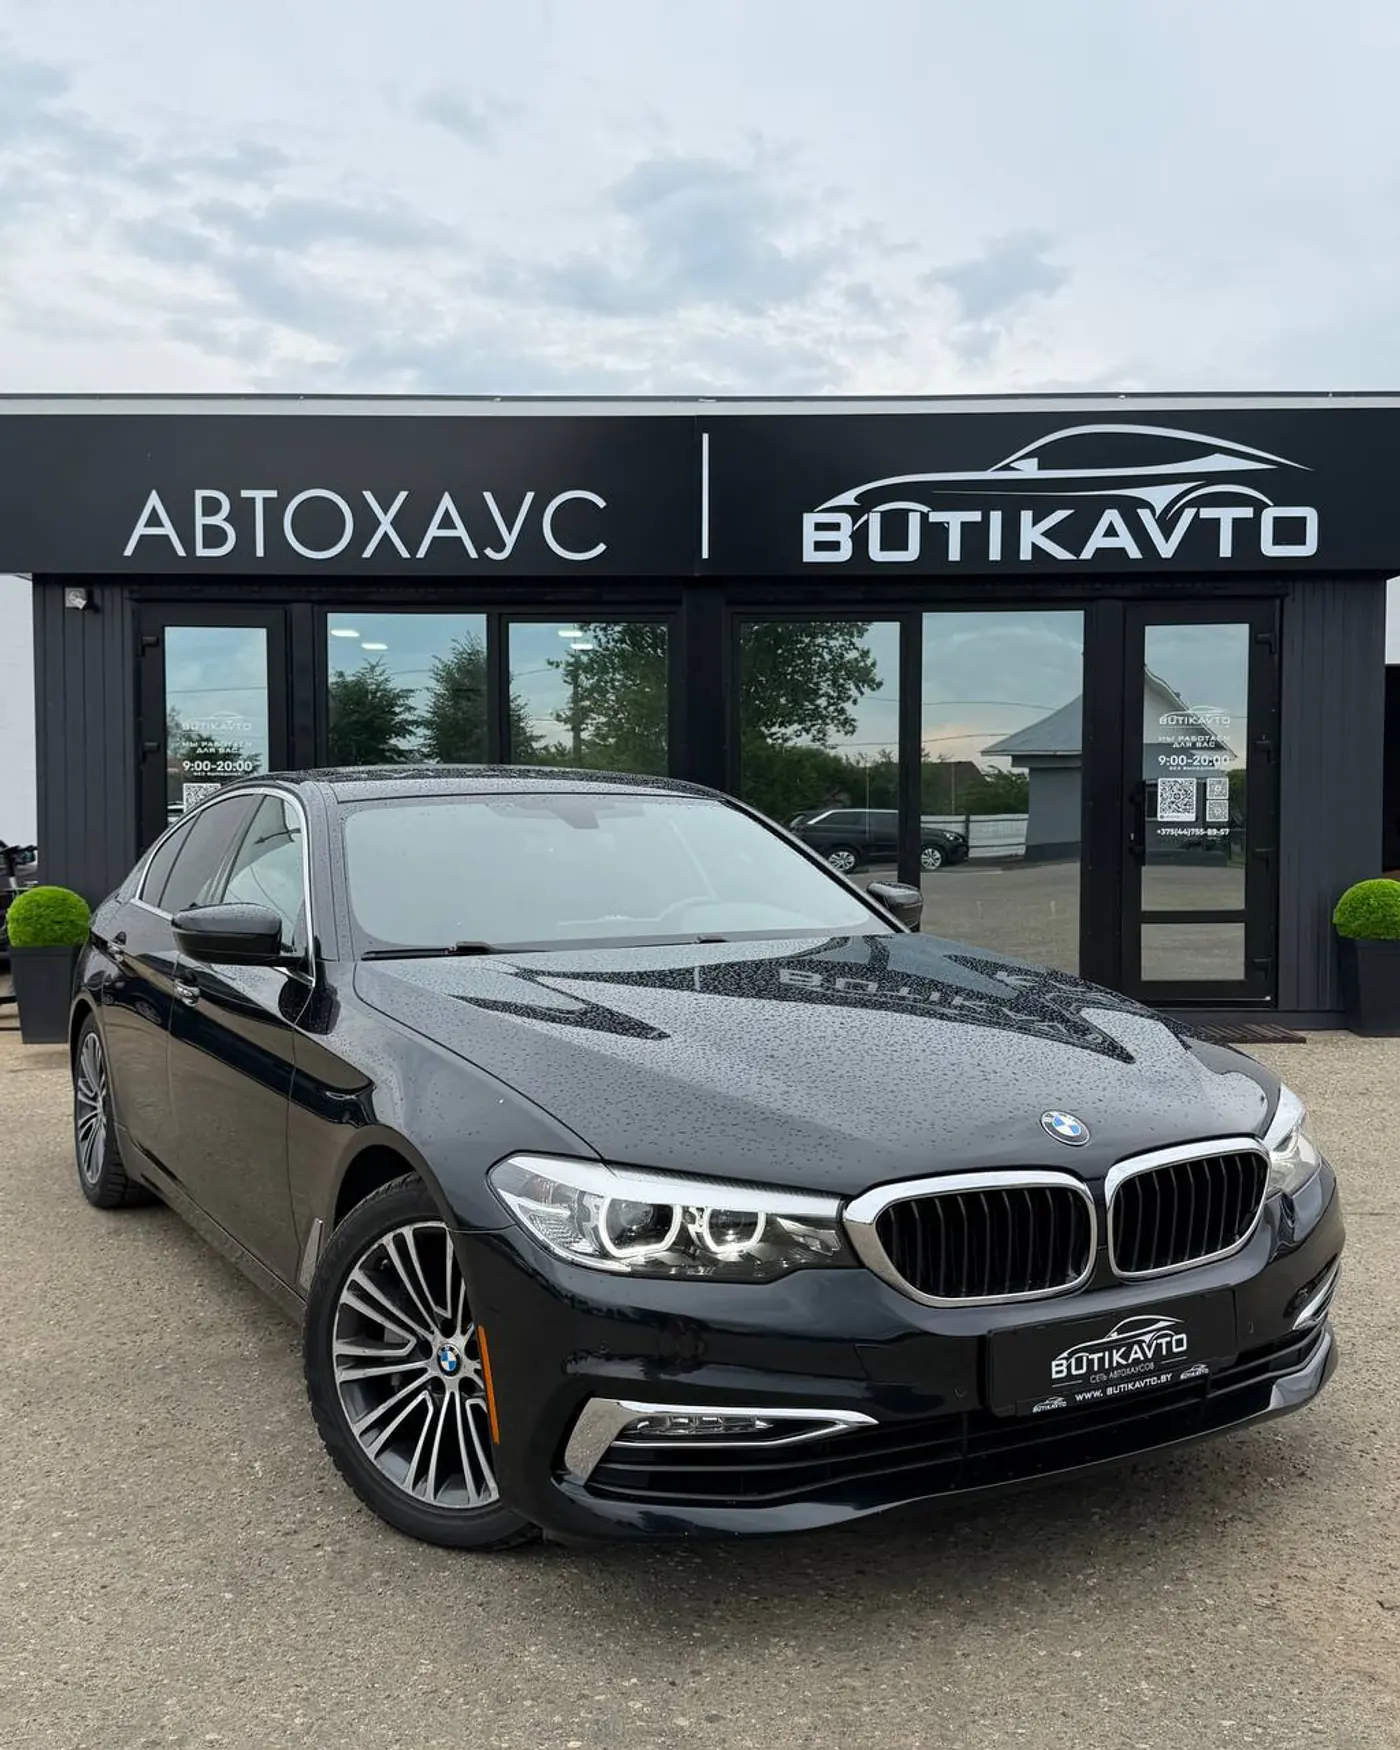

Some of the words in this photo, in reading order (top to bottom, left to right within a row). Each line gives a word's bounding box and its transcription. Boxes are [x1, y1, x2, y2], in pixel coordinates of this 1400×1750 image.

[123, 488, 607, 561] АВТОХАУС
[802, 505, 1318, 563] BUTIKAVTO
[182, 760, 253, 772] 9:00-20:00
[1158, 754, 1229, 766] 9:00-20:00
[1051, 1333, 1188, 1380] BUTIKAVTO
